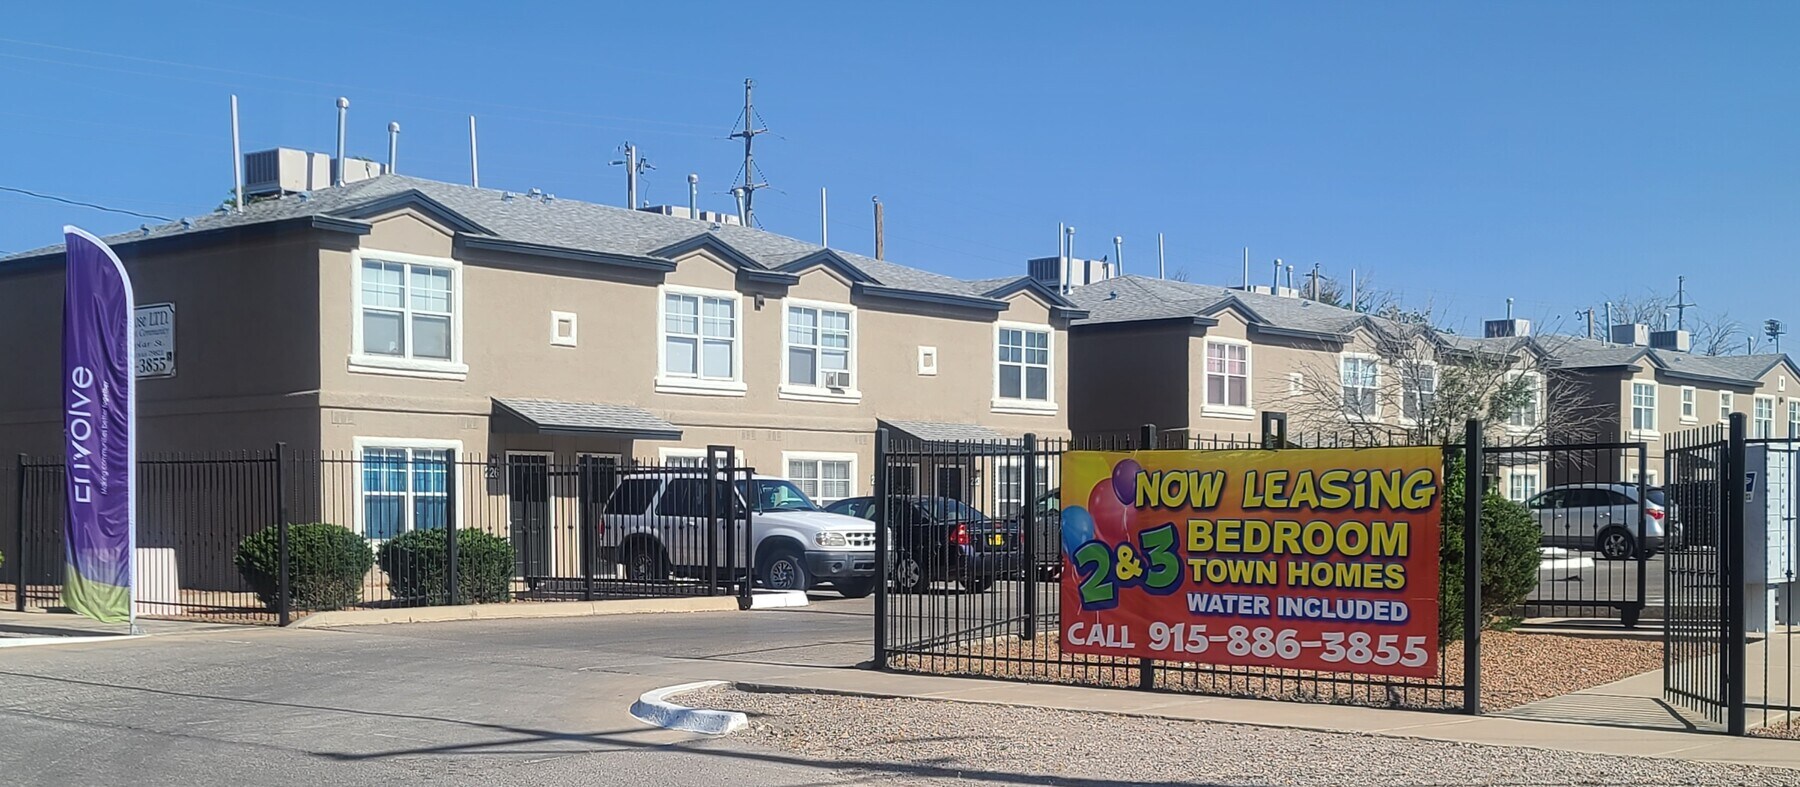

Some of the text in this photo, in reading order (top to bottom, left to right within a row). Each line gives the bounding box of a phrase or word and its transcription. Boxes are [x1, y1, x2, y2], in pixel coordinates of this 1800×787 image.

[1135, 470, 1225, 508] NOW
[1187, 518, 1409, 557] BEDROOM
[1187, 558, 1407, 589] TOWN HOMES
[1187, 593, 1409, 622] WATER INCLUDED
[1067, 622, 1429, 667] CALL 915-886-3855
